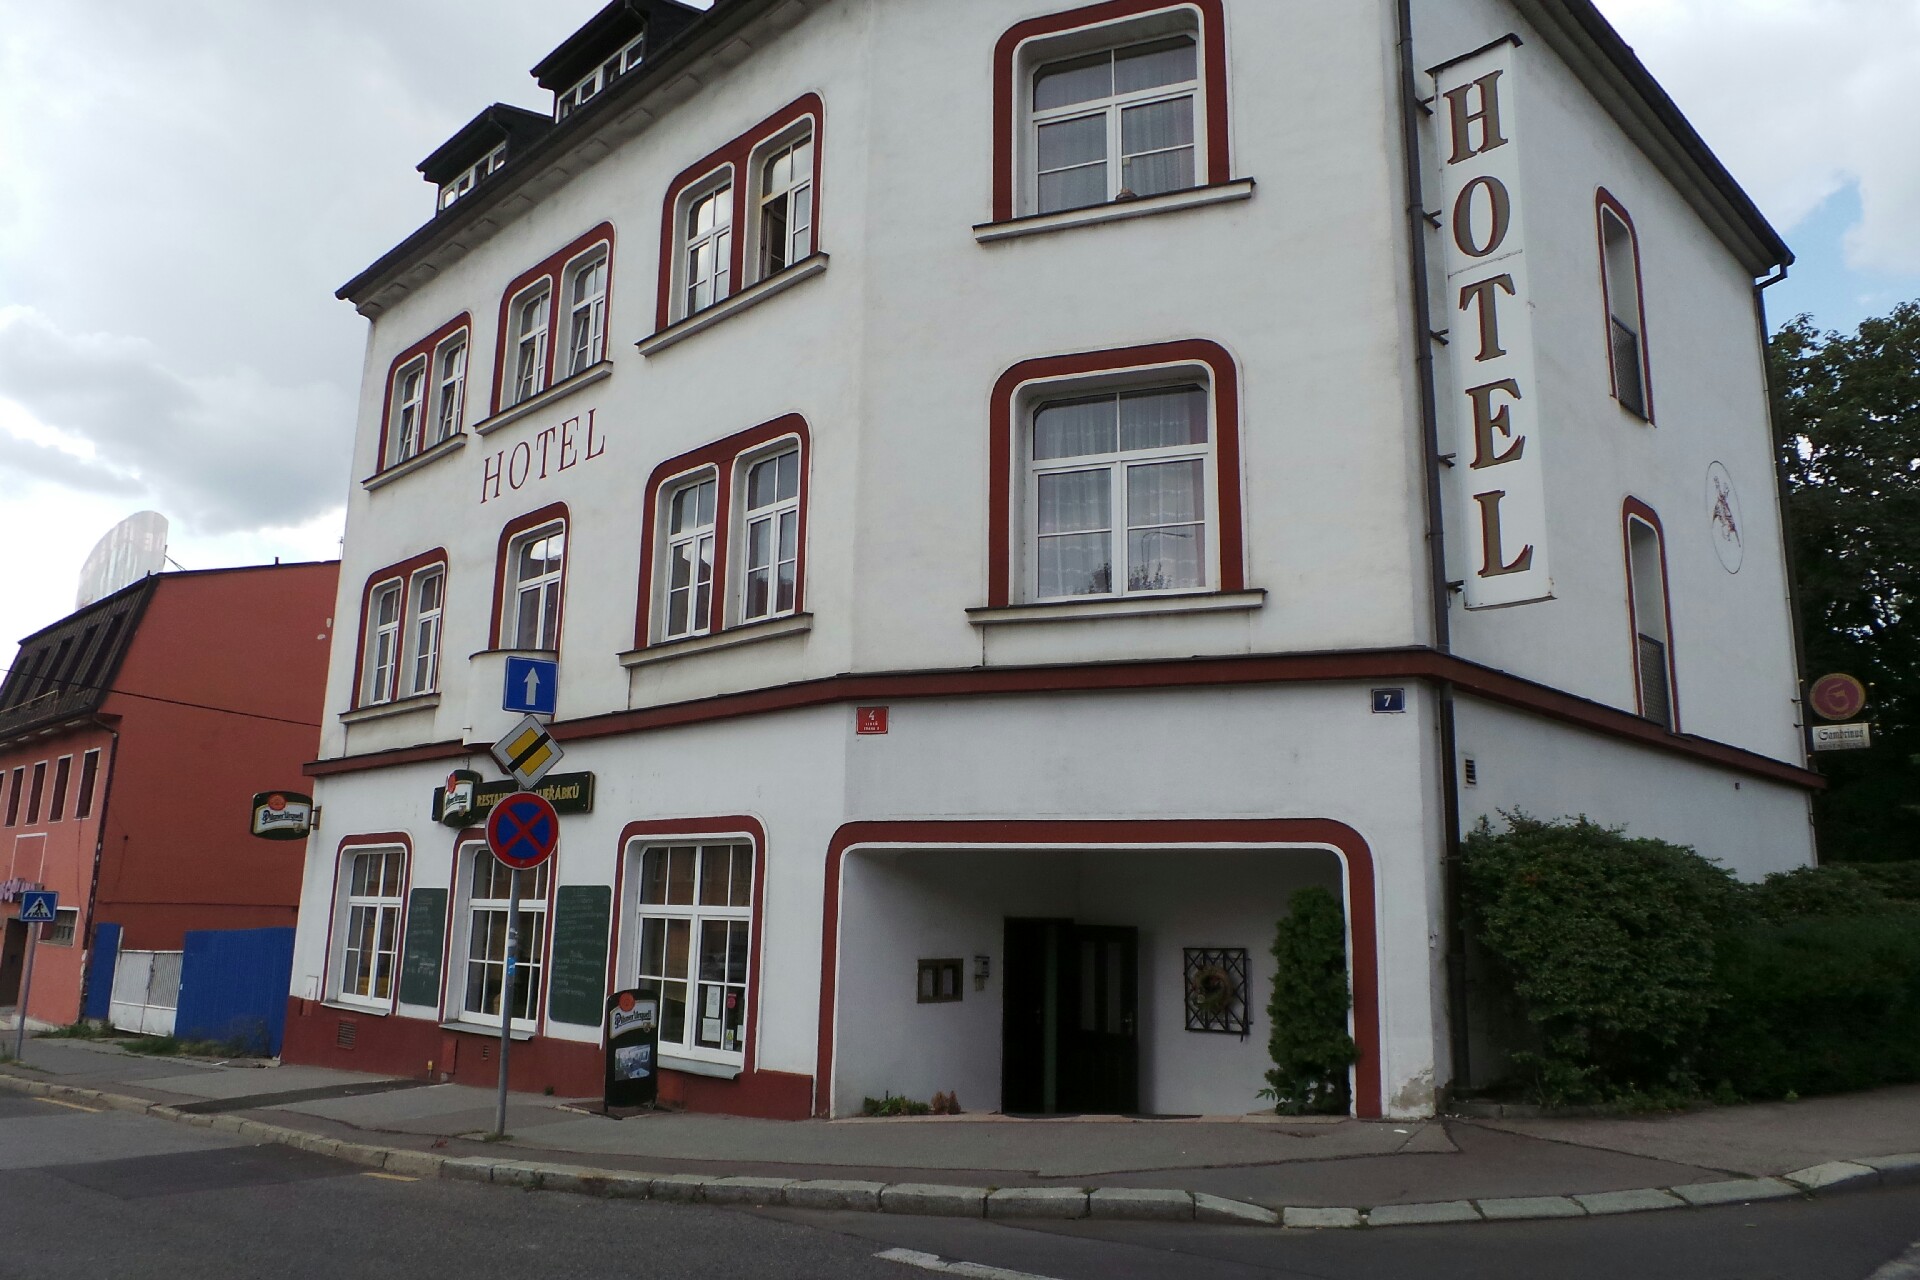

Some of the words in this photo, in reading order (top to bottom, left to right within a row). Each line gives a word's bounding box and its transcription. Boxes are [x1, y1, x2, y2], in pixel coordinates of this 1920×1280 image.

[1443, 69, 1533, 578] HOTEL
[480, 408, 605, 504] HOTEL
[1384, 694, 1392, 707] 7
[868, 710, 875, 721] 4
[1819, 728, 1864, 741] Gambrinus
